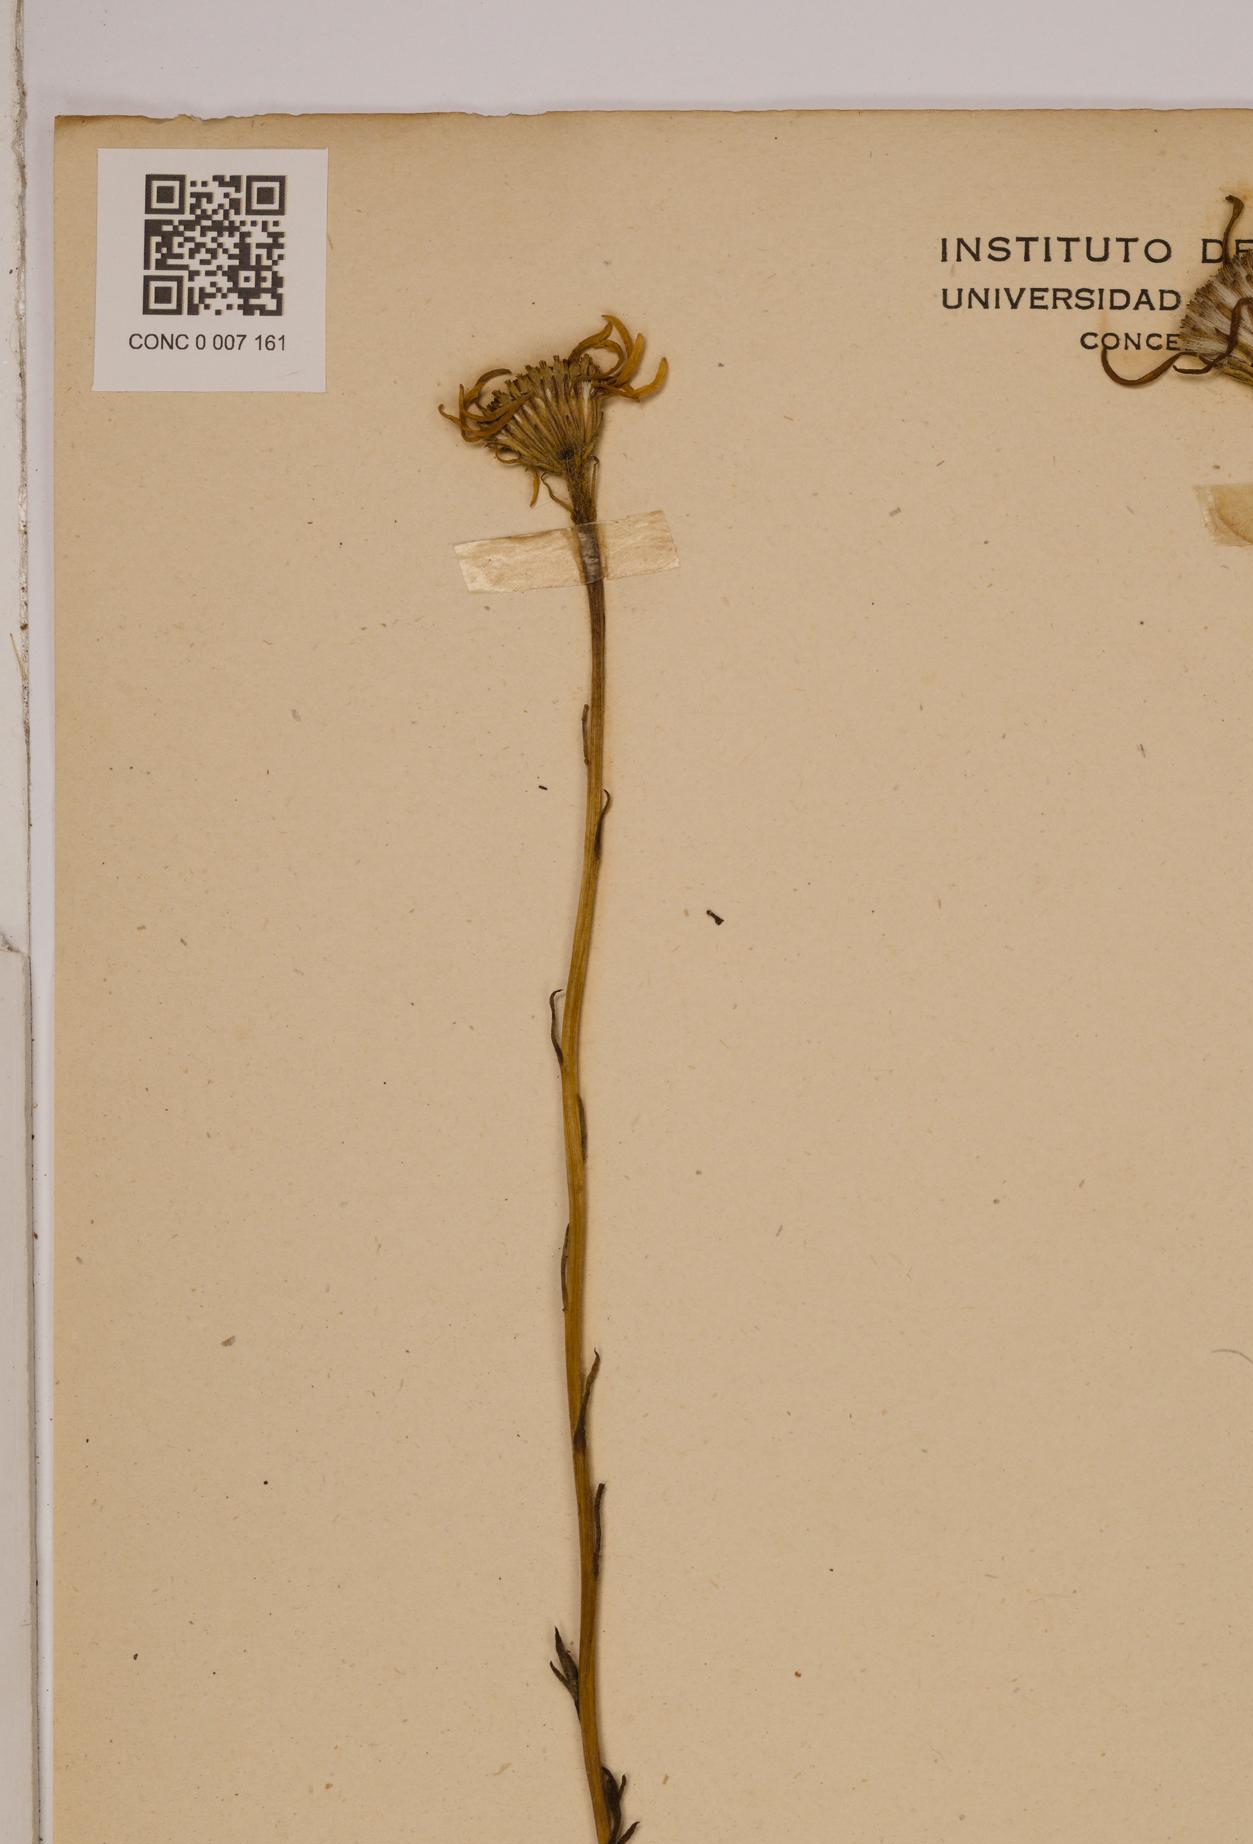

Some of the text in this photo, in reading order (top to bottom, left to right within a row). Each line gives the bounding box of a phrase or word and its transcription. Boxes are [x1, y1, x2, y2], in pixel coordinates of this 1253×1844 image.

[940, 236, 1173, 264] INSTITUTO
[941, 287, 1182, 311] UNIVERSIDAD
[128, 333, 286, 351] CONC 0 007 161
